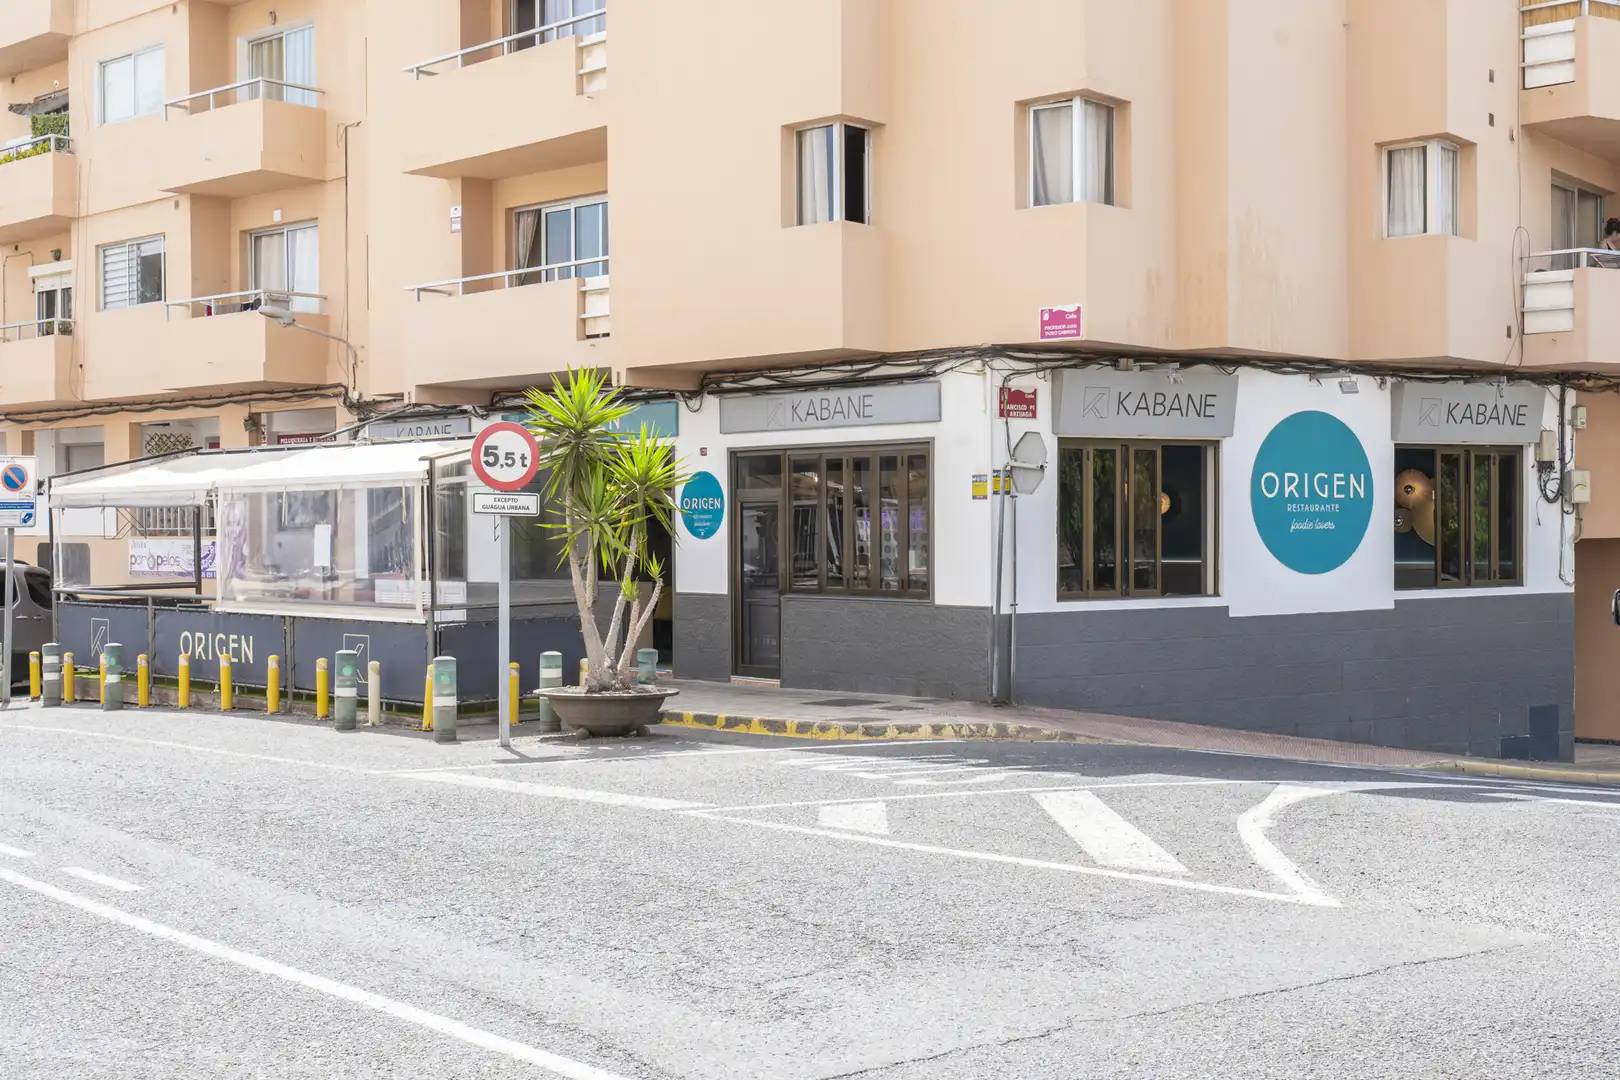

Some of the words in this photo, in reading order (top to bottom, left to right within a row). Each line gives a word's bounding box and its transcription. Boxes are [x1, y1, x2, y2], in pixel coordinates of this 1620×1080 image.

[791, 394, 873, 422] KABANE
[1117, 391, 1217, 418] KABANE
[1446, 402, 1528, 426] KABANE
[483, 445, 516, 469] 5,5
[520, 453, 528, 468] t
[1261, 472, 1364, 498] ORIGEN
[506, 504, 531, 512] URBANA
[683, 498, 721, 509] ORIGEN
[1287, 503, 1340, 512] RESTAURANTE
[1290, 518, 1313, 533] foodie
[1315, 517, 1335, 530] lovers
[180, 631, 253, 664] ORIGEN
